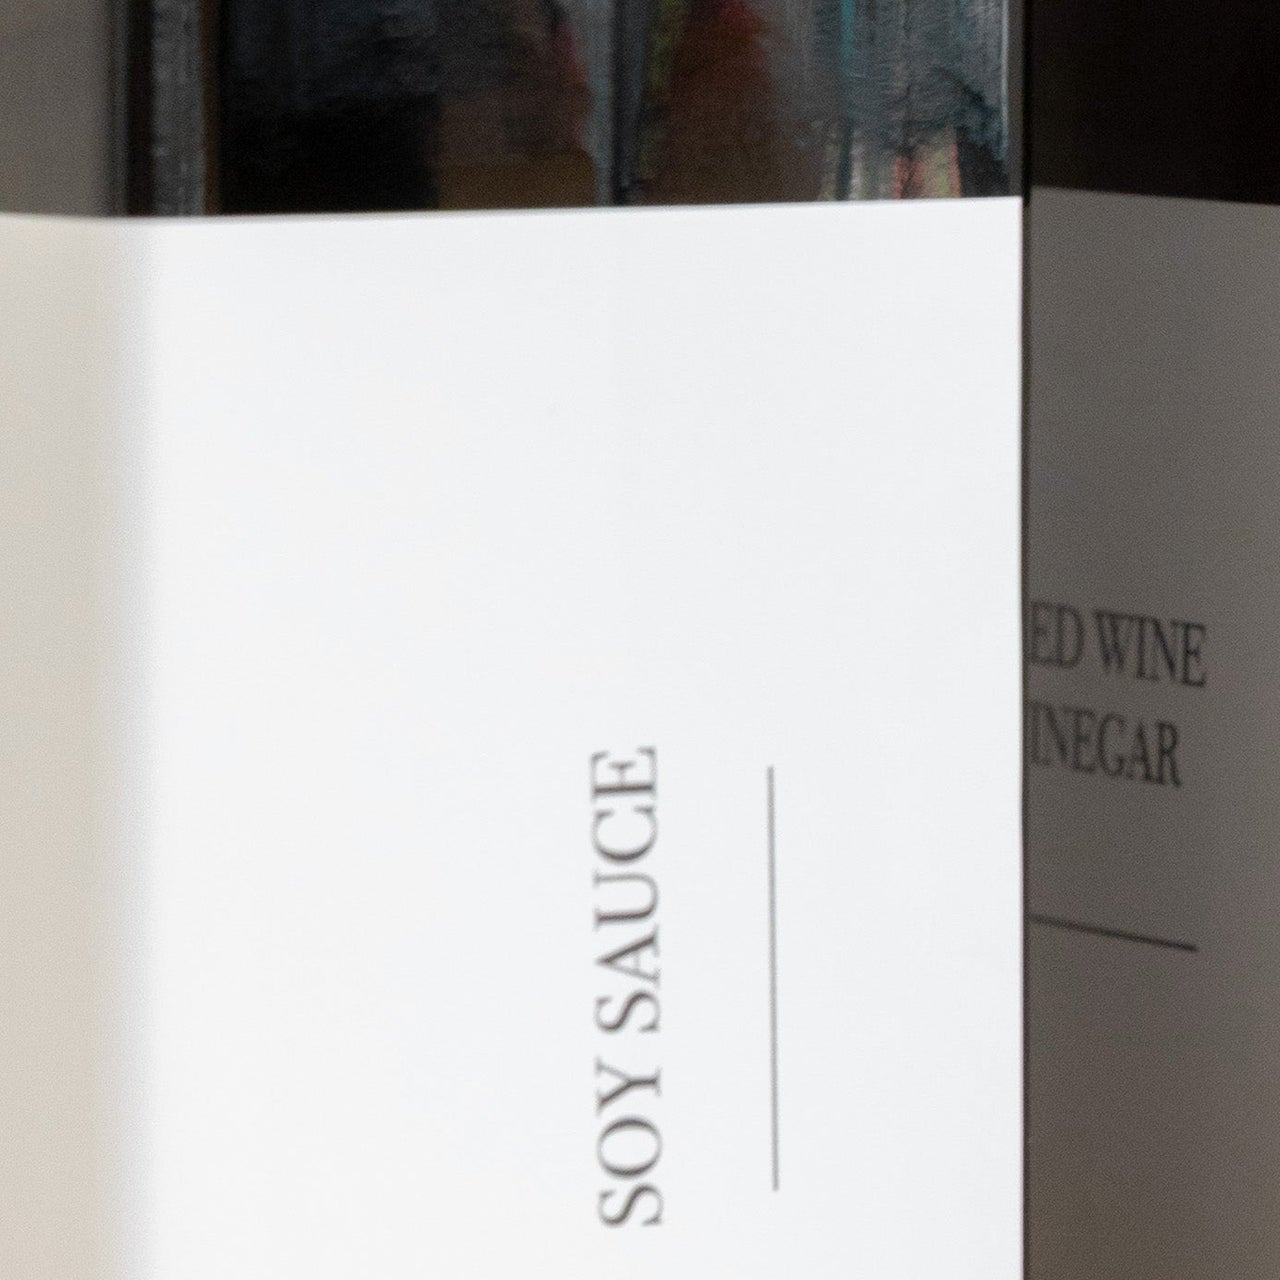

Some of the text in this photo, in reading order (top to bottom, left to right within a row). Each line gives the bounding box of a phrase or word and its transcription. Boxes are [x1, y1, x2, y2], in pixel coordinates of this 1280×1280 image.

[1027, 601, 1207, 688] ED WINE
[1026, 700, 1183, 788] INEGAR
[590, 746, 661, 1228] SOY SAUCE
